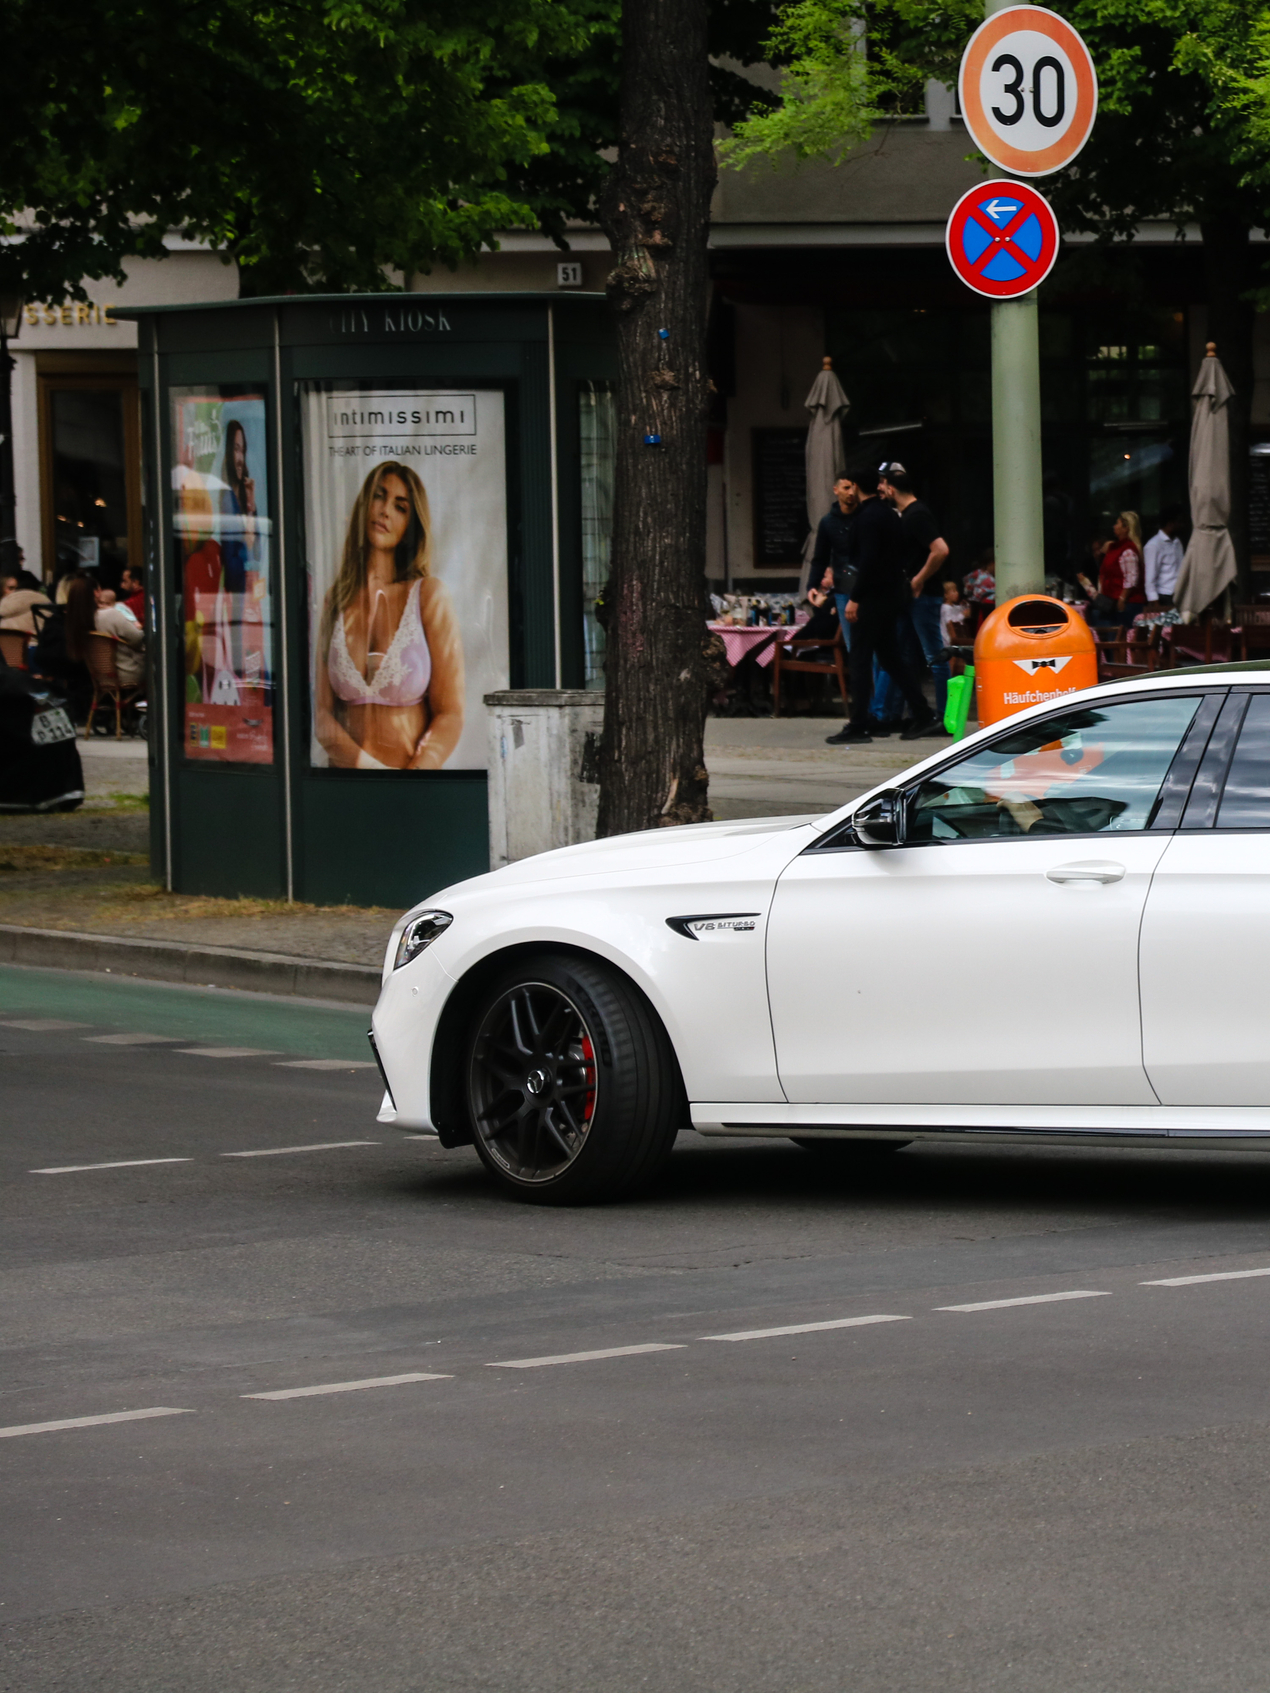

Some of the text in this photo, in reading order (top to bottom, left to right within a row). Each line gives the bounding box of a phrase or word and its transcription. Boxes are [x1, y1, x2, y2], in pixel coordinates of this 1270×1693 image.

[992, 54, 1065, 127] 30
[562, 267, 577, 282] 51
[385, 308, 451, 332] KIOSK
[334, 409, 465, 425] intimissimi
[346, 445, 360, 456] ART
[363, 445, 377, 456] OF
[379, 445, 421, 456] ITALIAN
[425, 444, 477, 455] LINGERIE
[693, 922, 715, 931] V8
